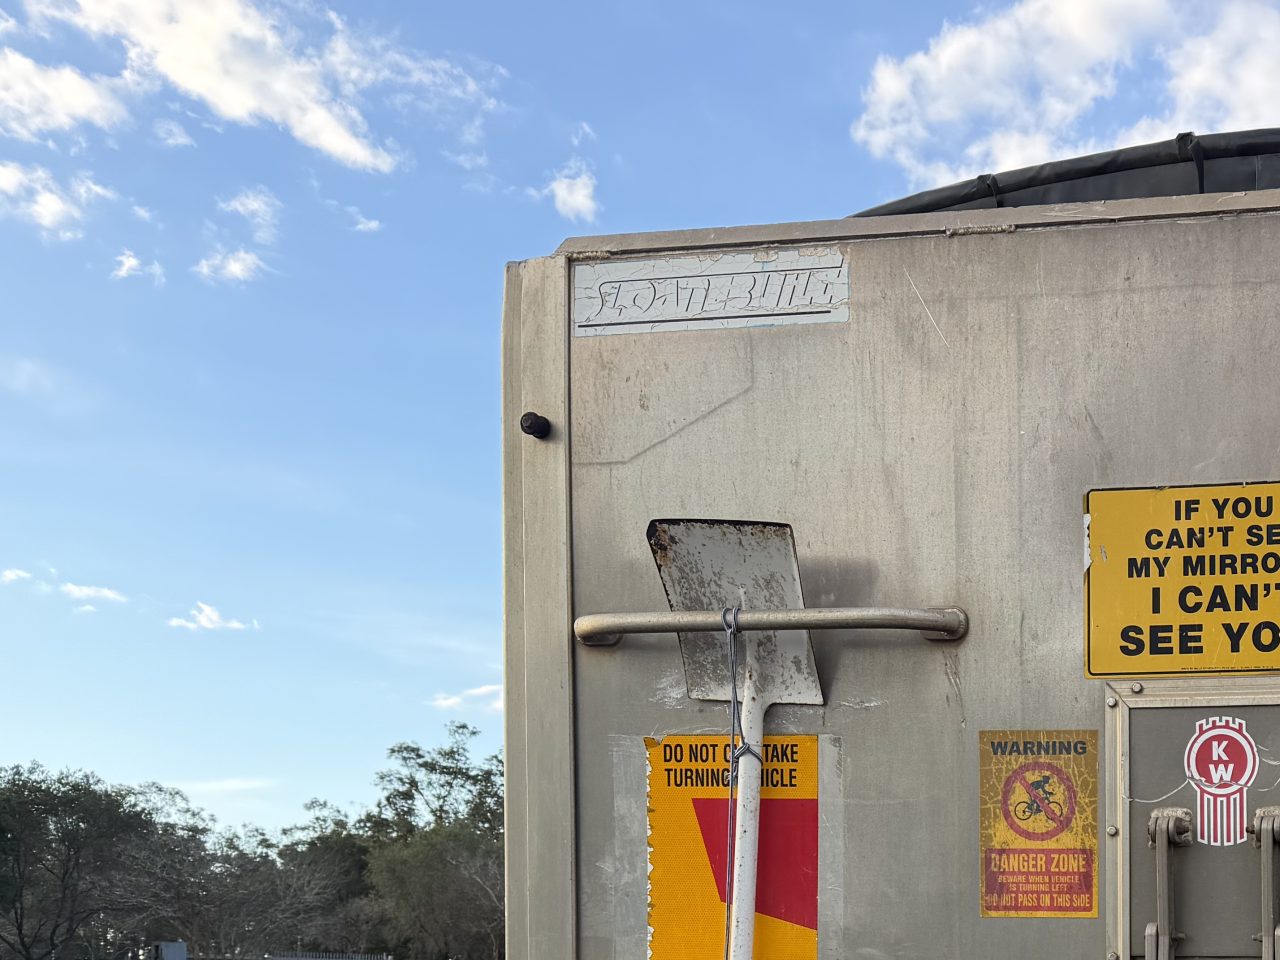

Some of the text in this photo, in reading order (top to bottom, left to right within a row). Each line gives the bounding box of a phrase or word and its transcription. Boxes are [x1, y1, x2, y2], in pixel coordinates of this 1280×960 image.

[1174, 496, 1273, 521] IF YOU
[1145, 525, 1234, 550] CAN'T
[1127, 556, 1171, 578] MY
[1151, 587, 1161, 614] I
[1119, 623, 1204, 657] SEE
[663, 744, 799, 763] DO NOT OTAKE
[990, 740, 1087, 756] WARNING
[665, 768, 731, 787] TURNING
[991, 853, 1087, 872] DANGER ZONE
[998, 875, 1080, 883] BEWARE WHEN VEHICLE
[1009, 883, 1068, 892] IS TURNING LEFT
[1001, 894, 1015, 907] NOT
[1018, 894, 1038, 907] PASS
[1039, 894, 1051, 907] ON
[1052, 894, 1071, 907] THIS
[1072, 894, 1090, 907] SIDE
